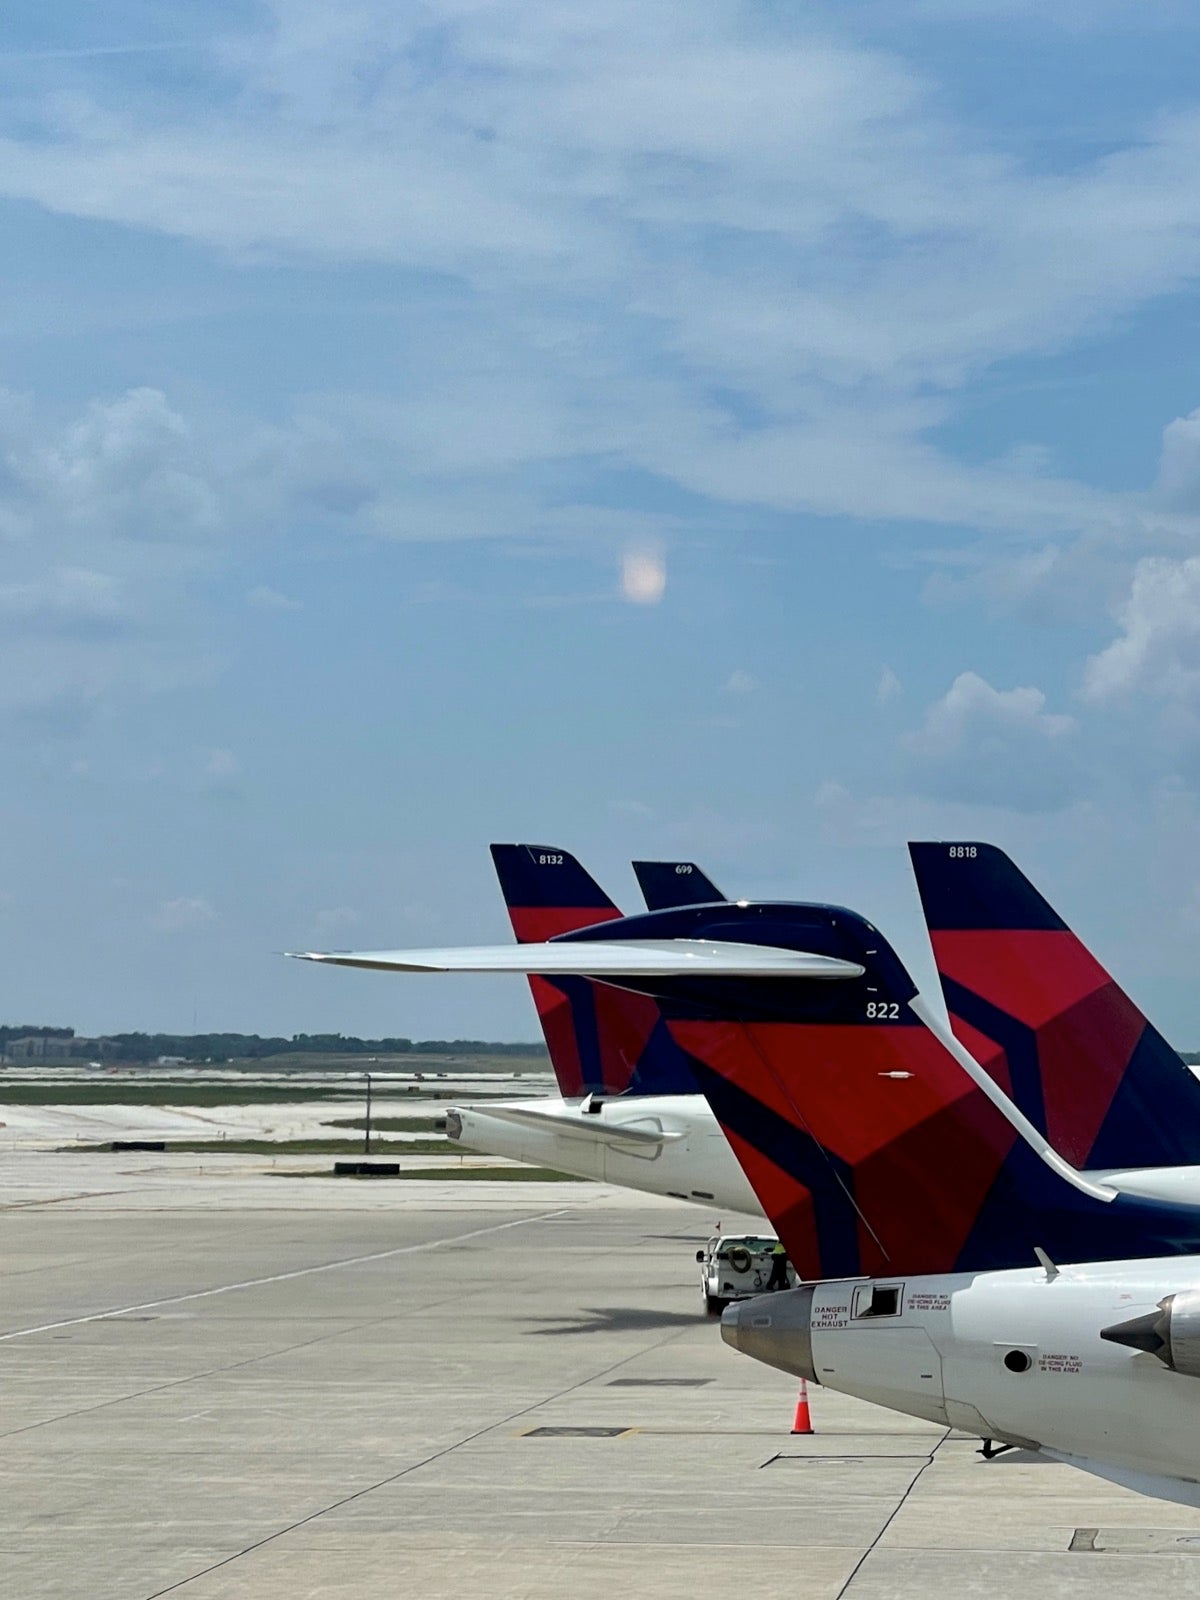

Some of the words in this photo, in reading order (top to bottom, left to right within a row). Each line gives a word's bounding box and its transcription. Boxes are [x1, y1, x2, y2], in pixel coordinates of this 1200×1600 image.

[949, 846, 977, 858] 8818
[539, 855, 563, 864] 8132
[675, 865, 693, 874] 699
[866, 1002, 900, 1019] 822
[811, 1320, 848, 1328] EXHAUST
